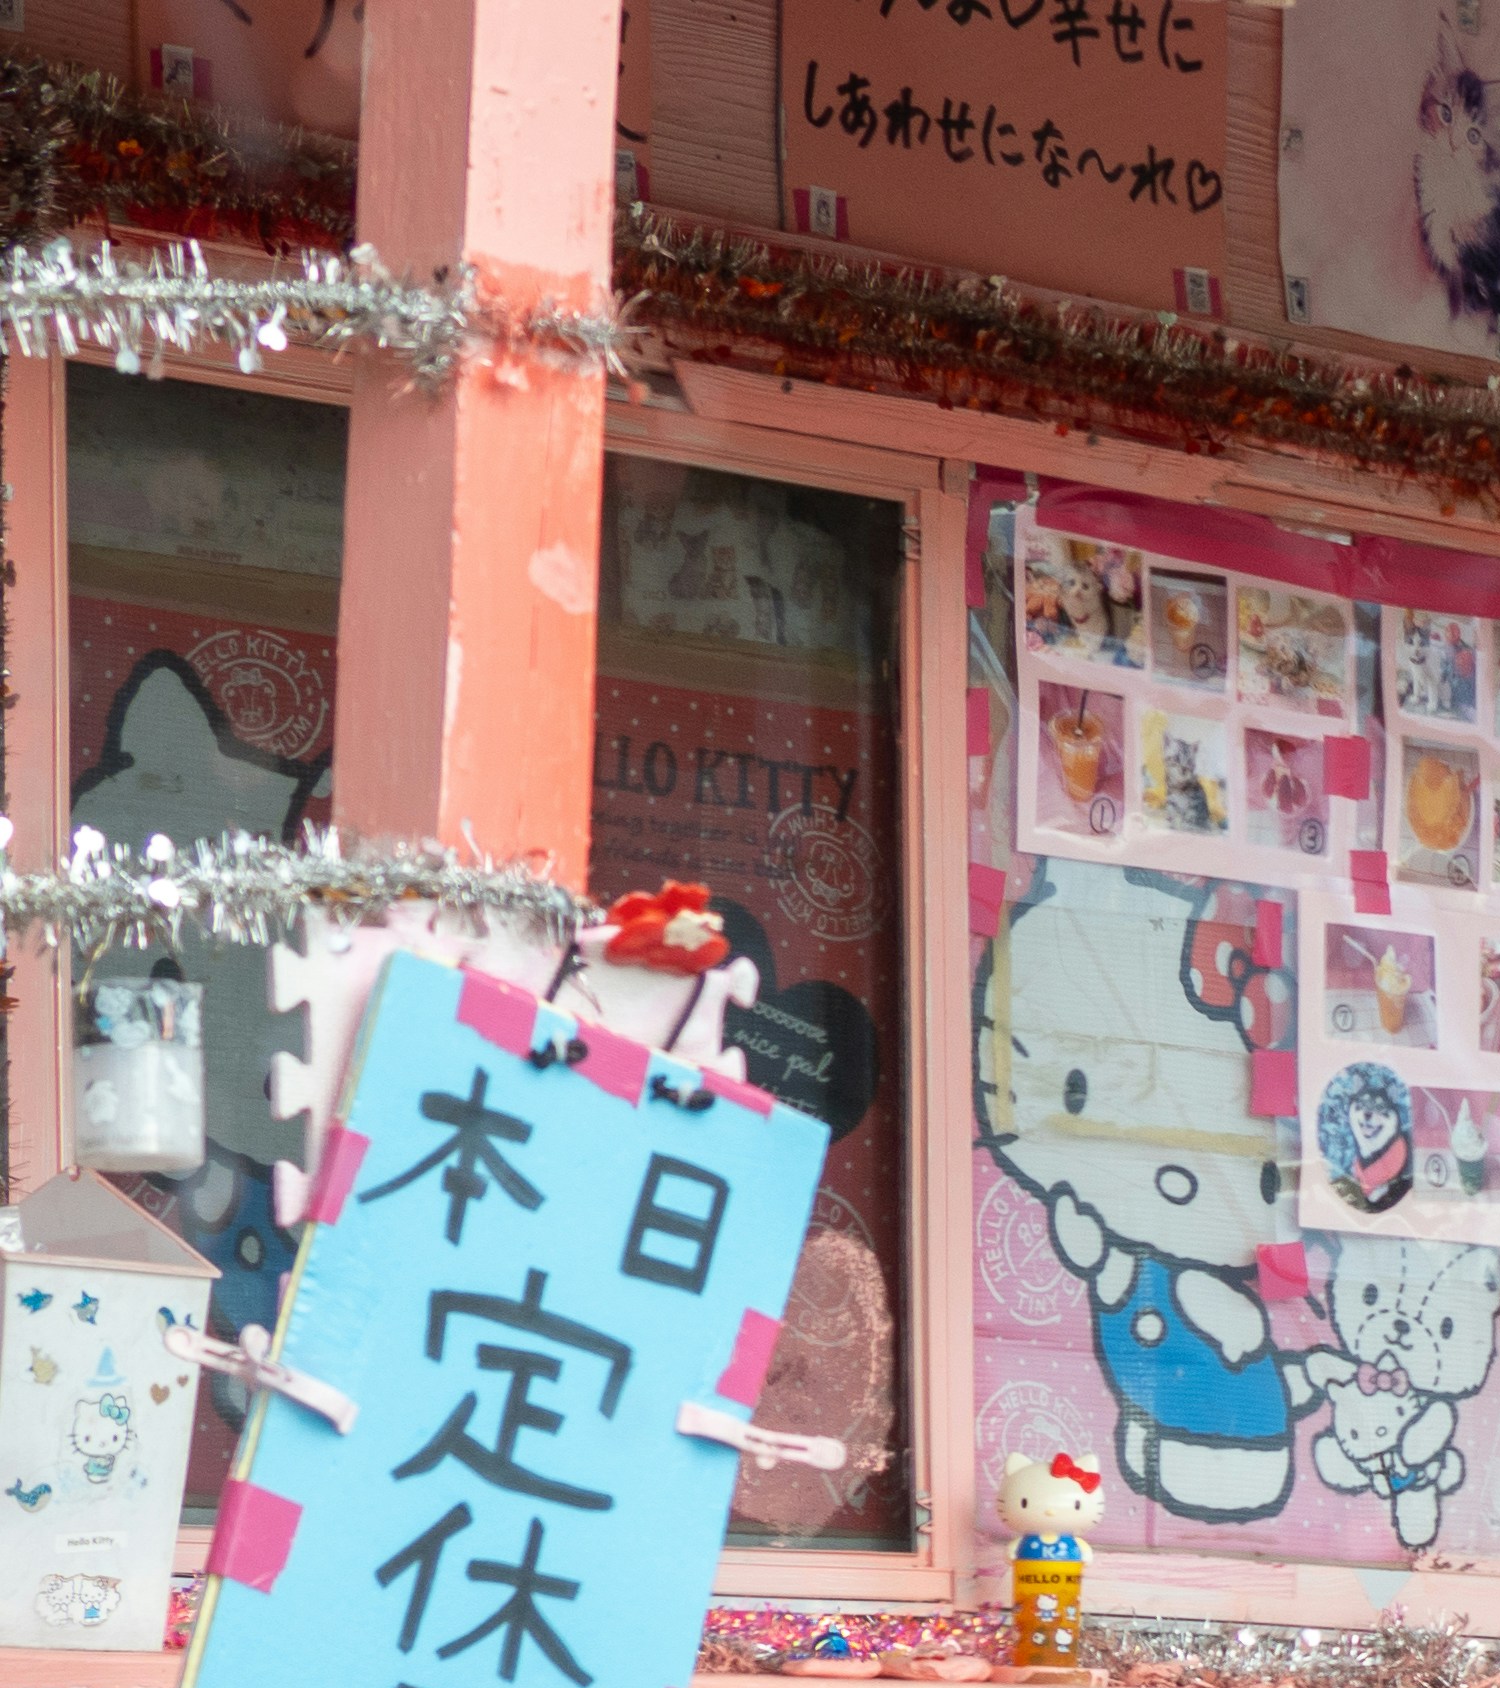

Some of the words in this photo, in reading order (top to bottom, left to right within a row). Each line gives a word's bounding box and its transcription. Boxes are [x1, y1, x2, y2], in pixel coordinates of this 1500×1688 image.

[695, 747, 859, 821] KITTY
[67, 1536, 89, 1549] Hello
[90, 1536, 115, 1550] Kitty
[1017, 1573, 1062, 1586] HELLO
